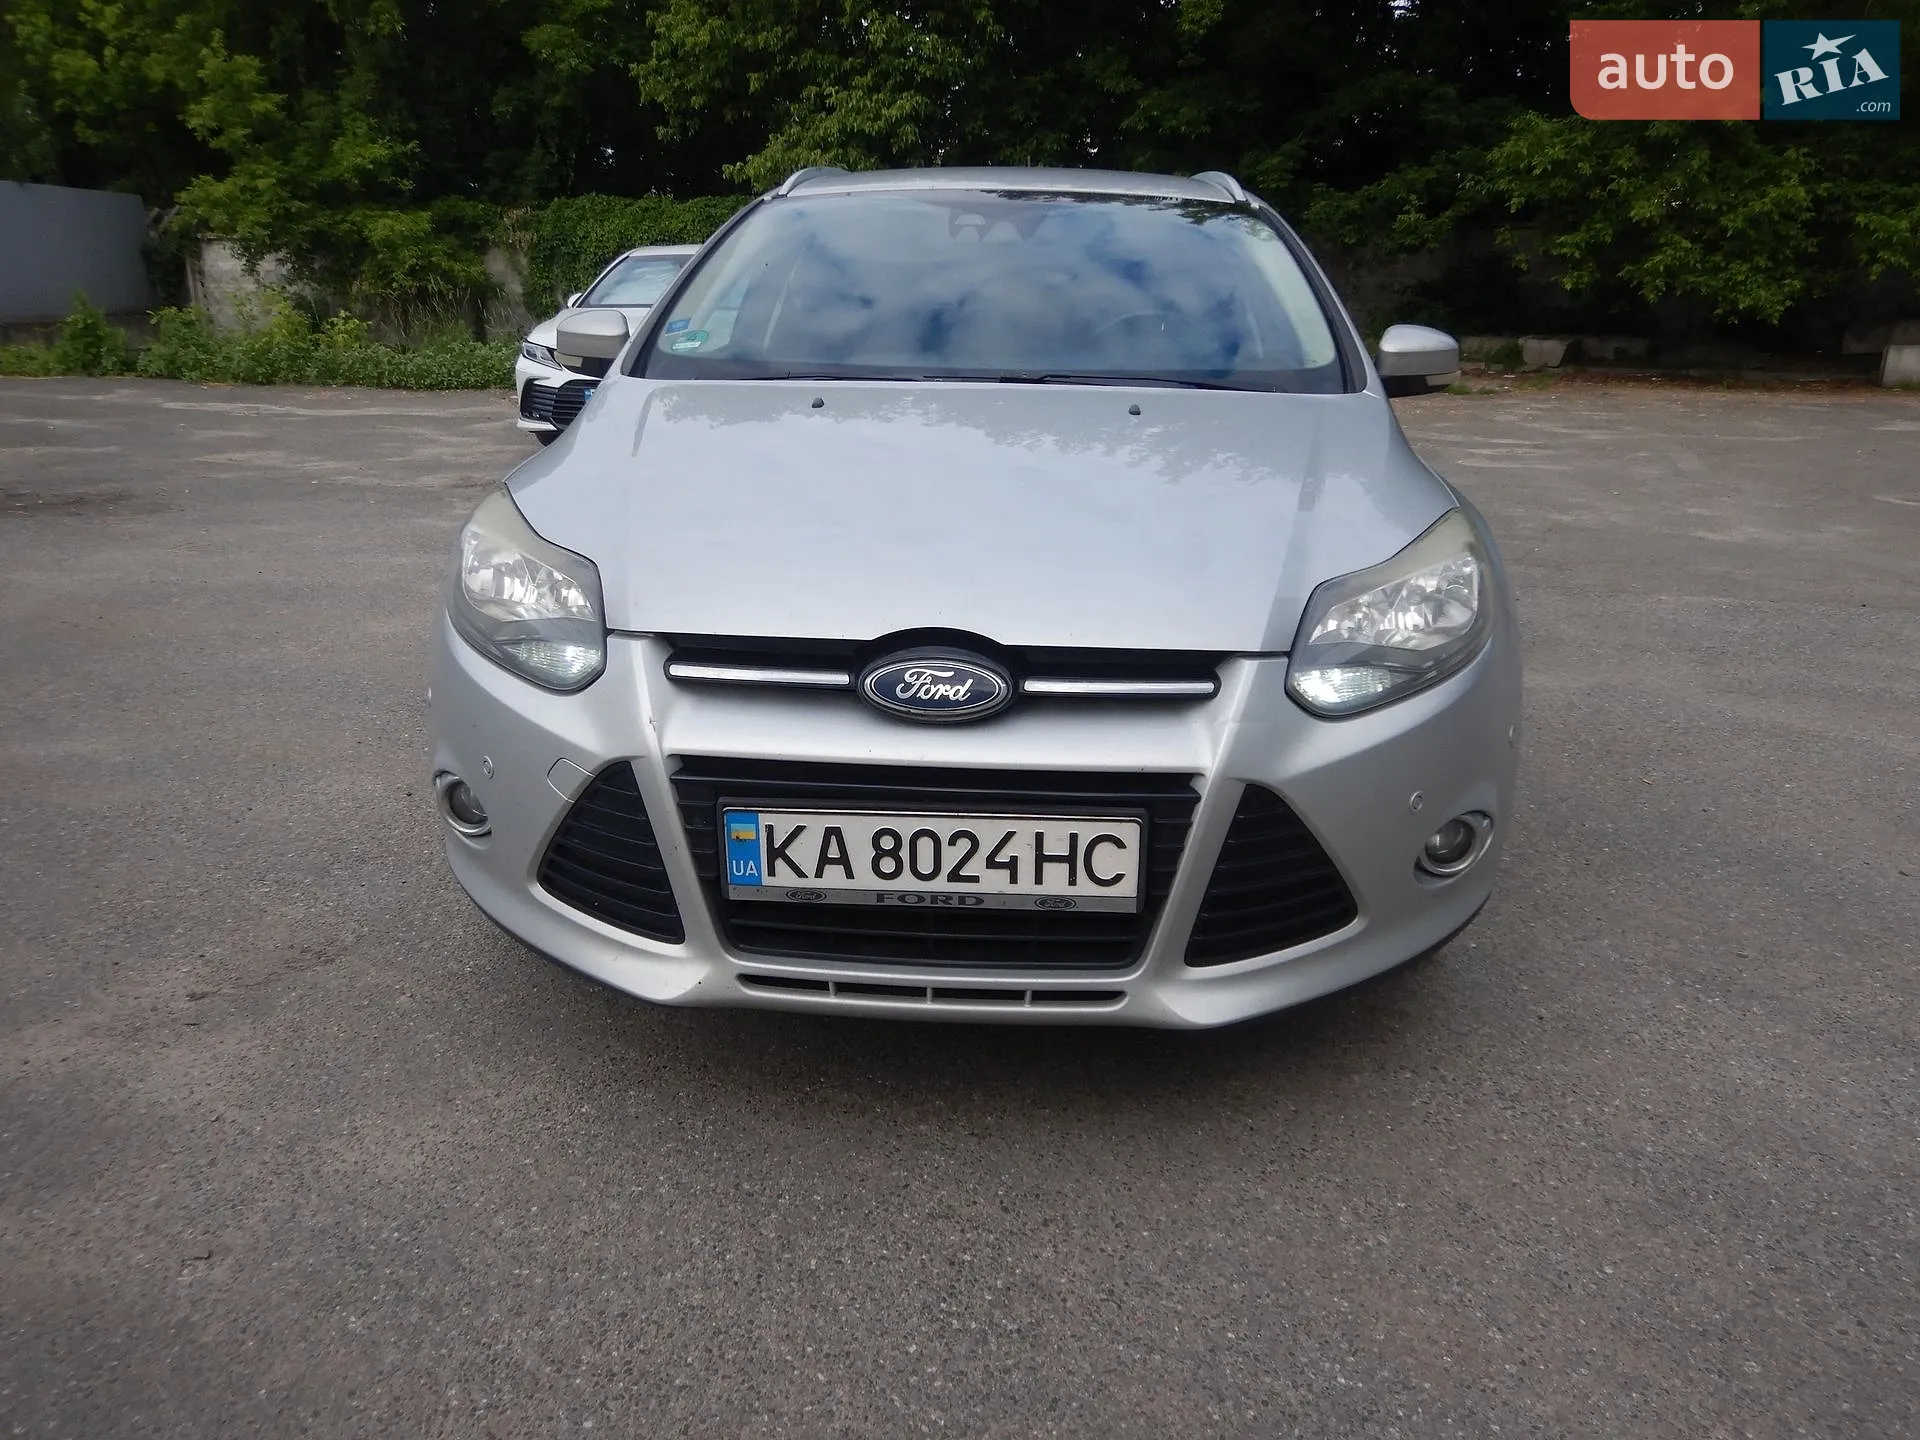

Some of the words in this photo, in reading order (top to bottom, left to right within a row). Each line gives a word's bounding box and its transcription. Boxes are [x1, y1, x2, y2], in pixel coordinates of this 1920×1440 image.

[896, 668, 974, 701] Ford
[765, 823, 855, 880] KA
[871, 827, 1019, 885] 8024
[1034, 830, 1128, 888] HC
[732, 860, 758, 876] UA
[876, 892, 985, 906] FORD
